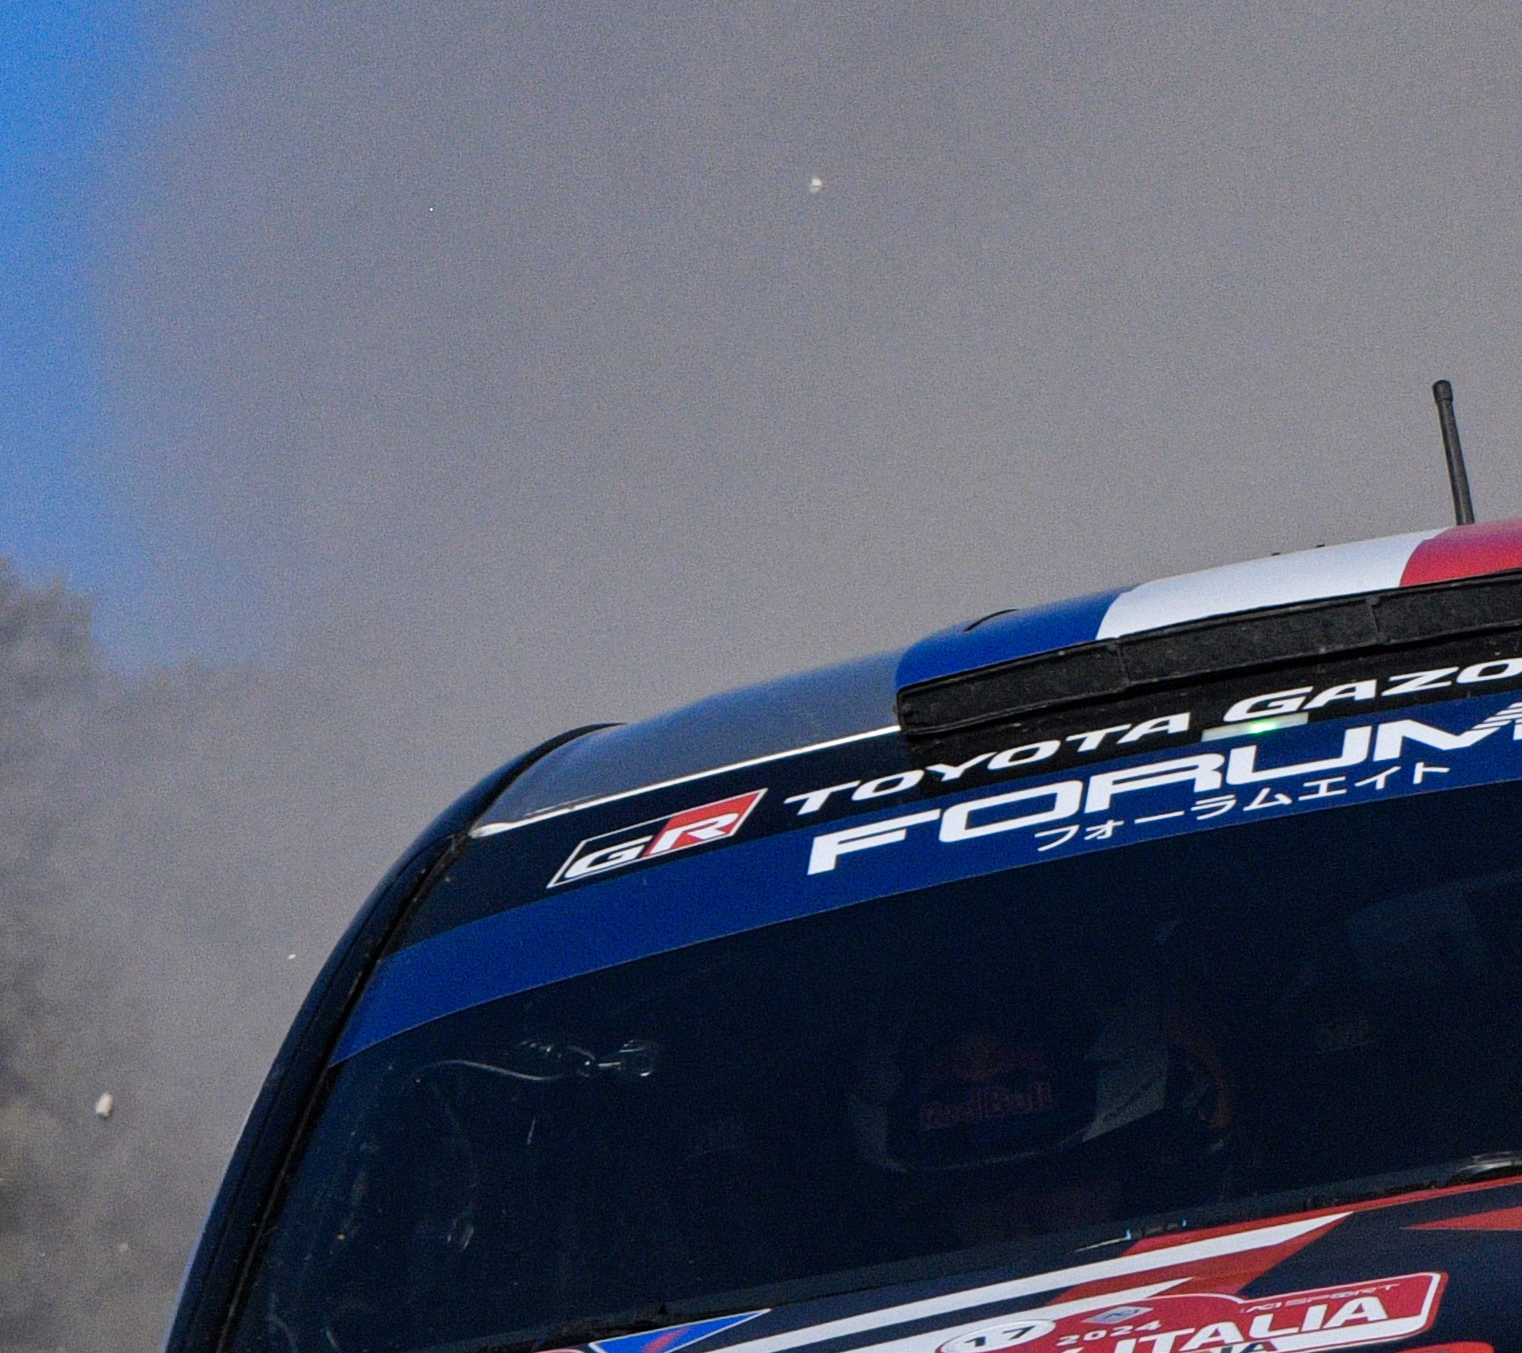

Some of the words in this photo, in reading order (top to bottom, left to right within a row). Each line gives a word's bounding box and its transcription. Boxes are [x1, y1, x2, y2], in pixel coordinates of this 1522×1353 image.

[784, 712, 1191, 815] TOYOTA
[563, 812, 740, 879] GR
[1033, 760, 1452, 853] フォーラムエイト
[1055, 1319, 1162, 1347] 2024
